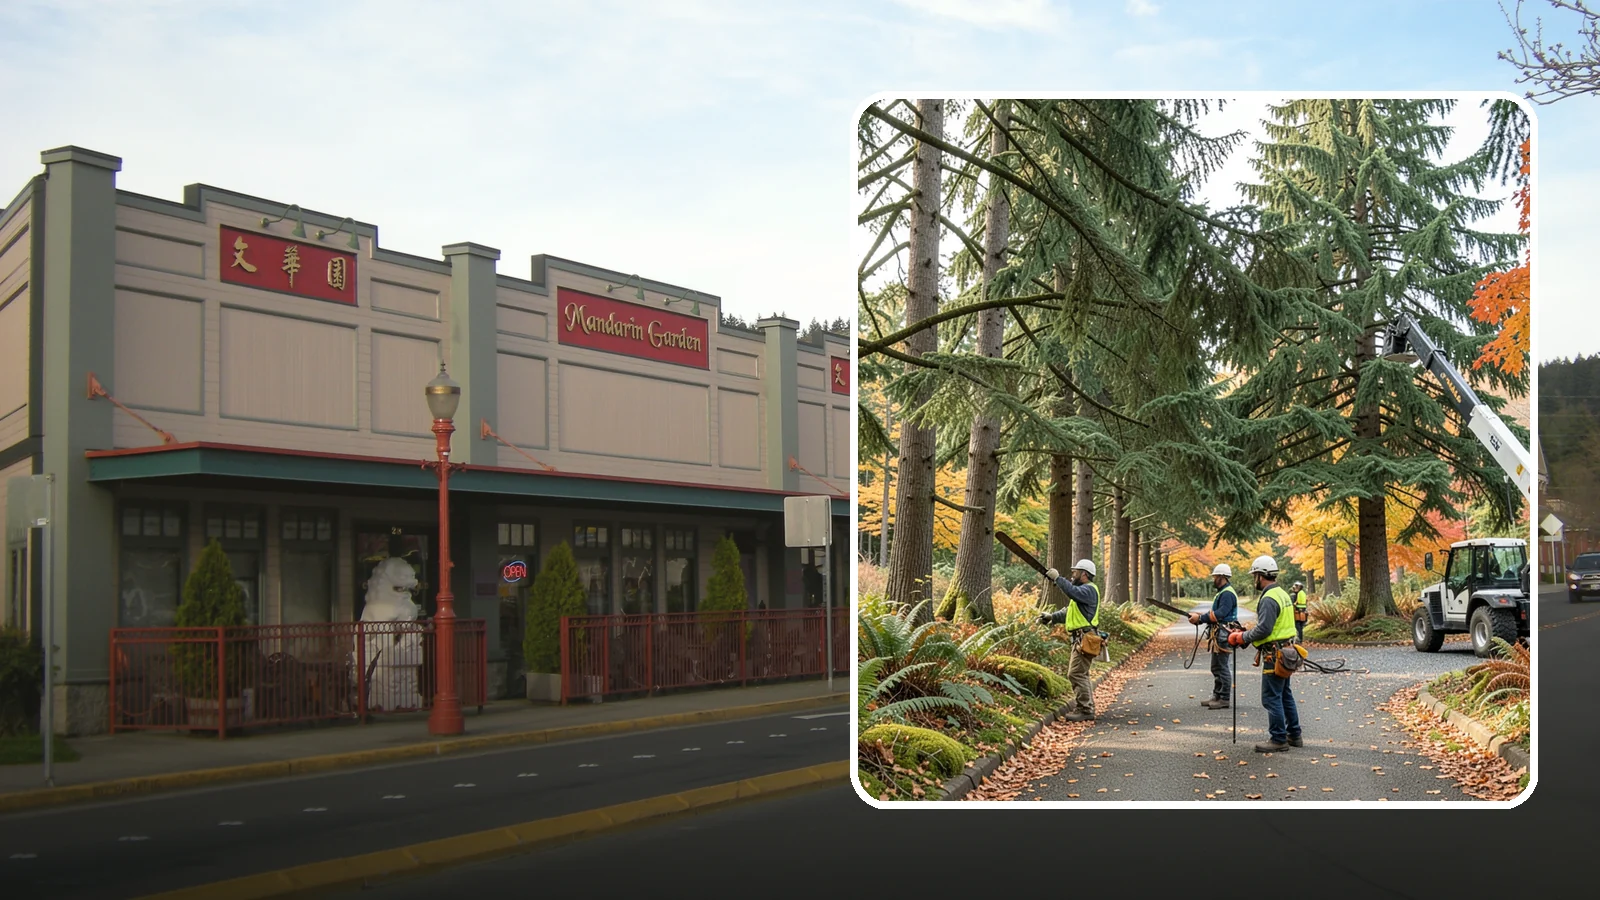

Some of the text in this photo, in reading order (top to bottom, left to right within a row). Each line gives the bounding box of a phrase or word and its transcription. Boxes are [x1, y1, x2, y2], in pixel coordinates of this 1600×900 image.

[231, 236, 346, 291] 文華園
[564, 302, 702, 352] Mandarin Garden
[503, 565, 527, 578] OPEN
